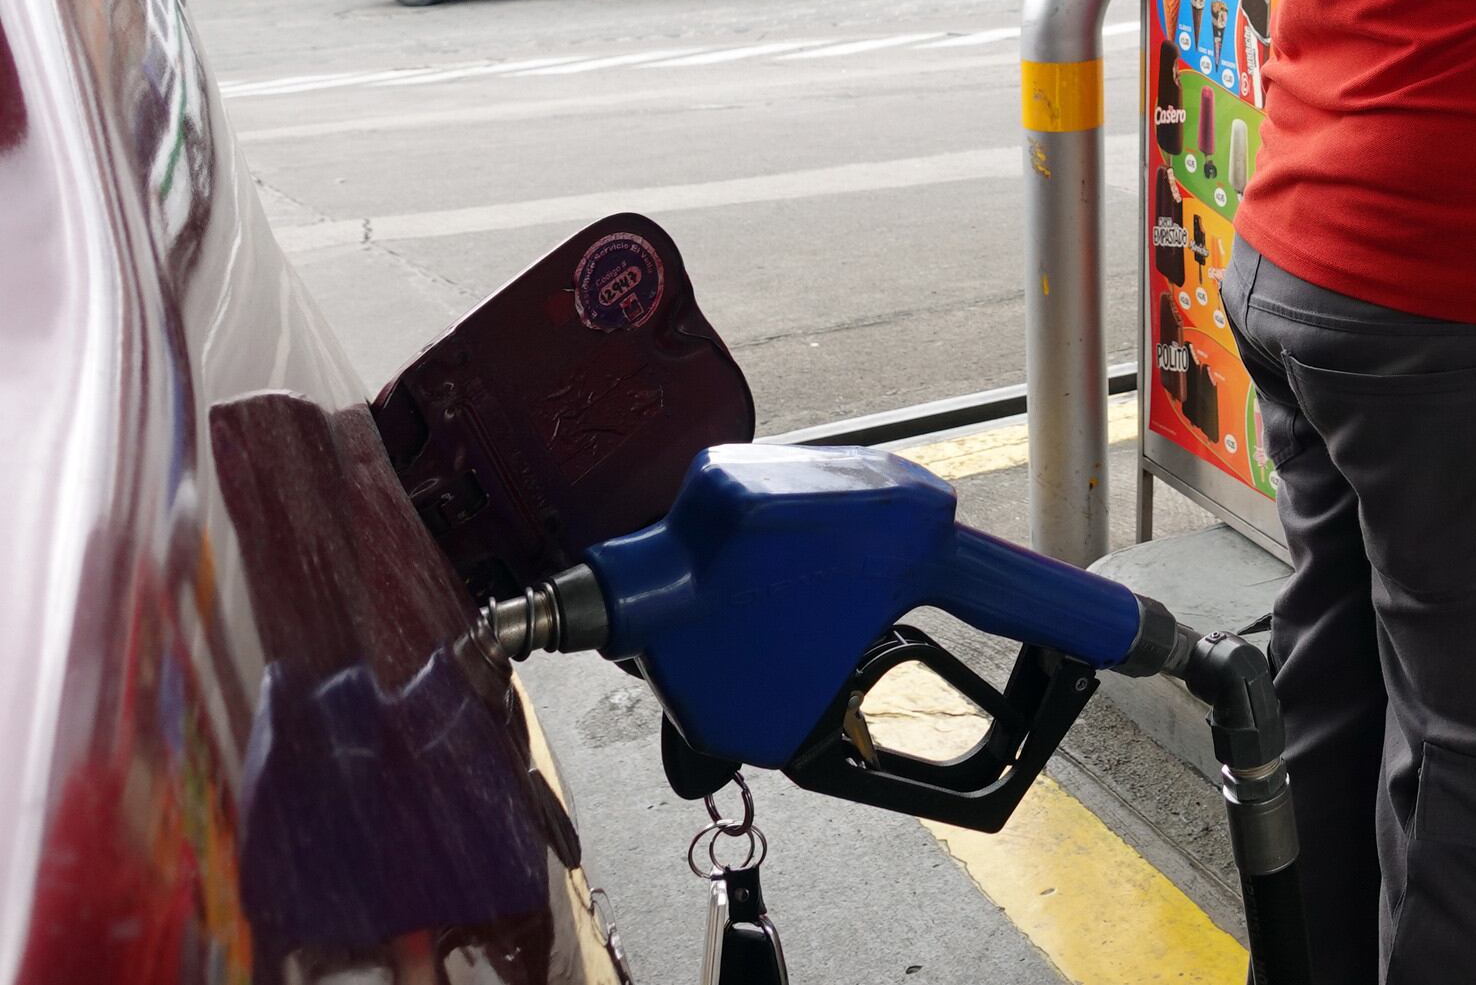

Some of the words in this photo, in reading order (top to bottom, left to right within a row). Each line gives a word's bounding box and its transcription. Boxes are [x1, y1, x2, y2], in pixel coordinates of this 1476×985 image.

[1155, 107, 1186, 125] Casero
[594, 242, 629, 259] Servicio
[1156, 345, 1189, 371] POLITO
